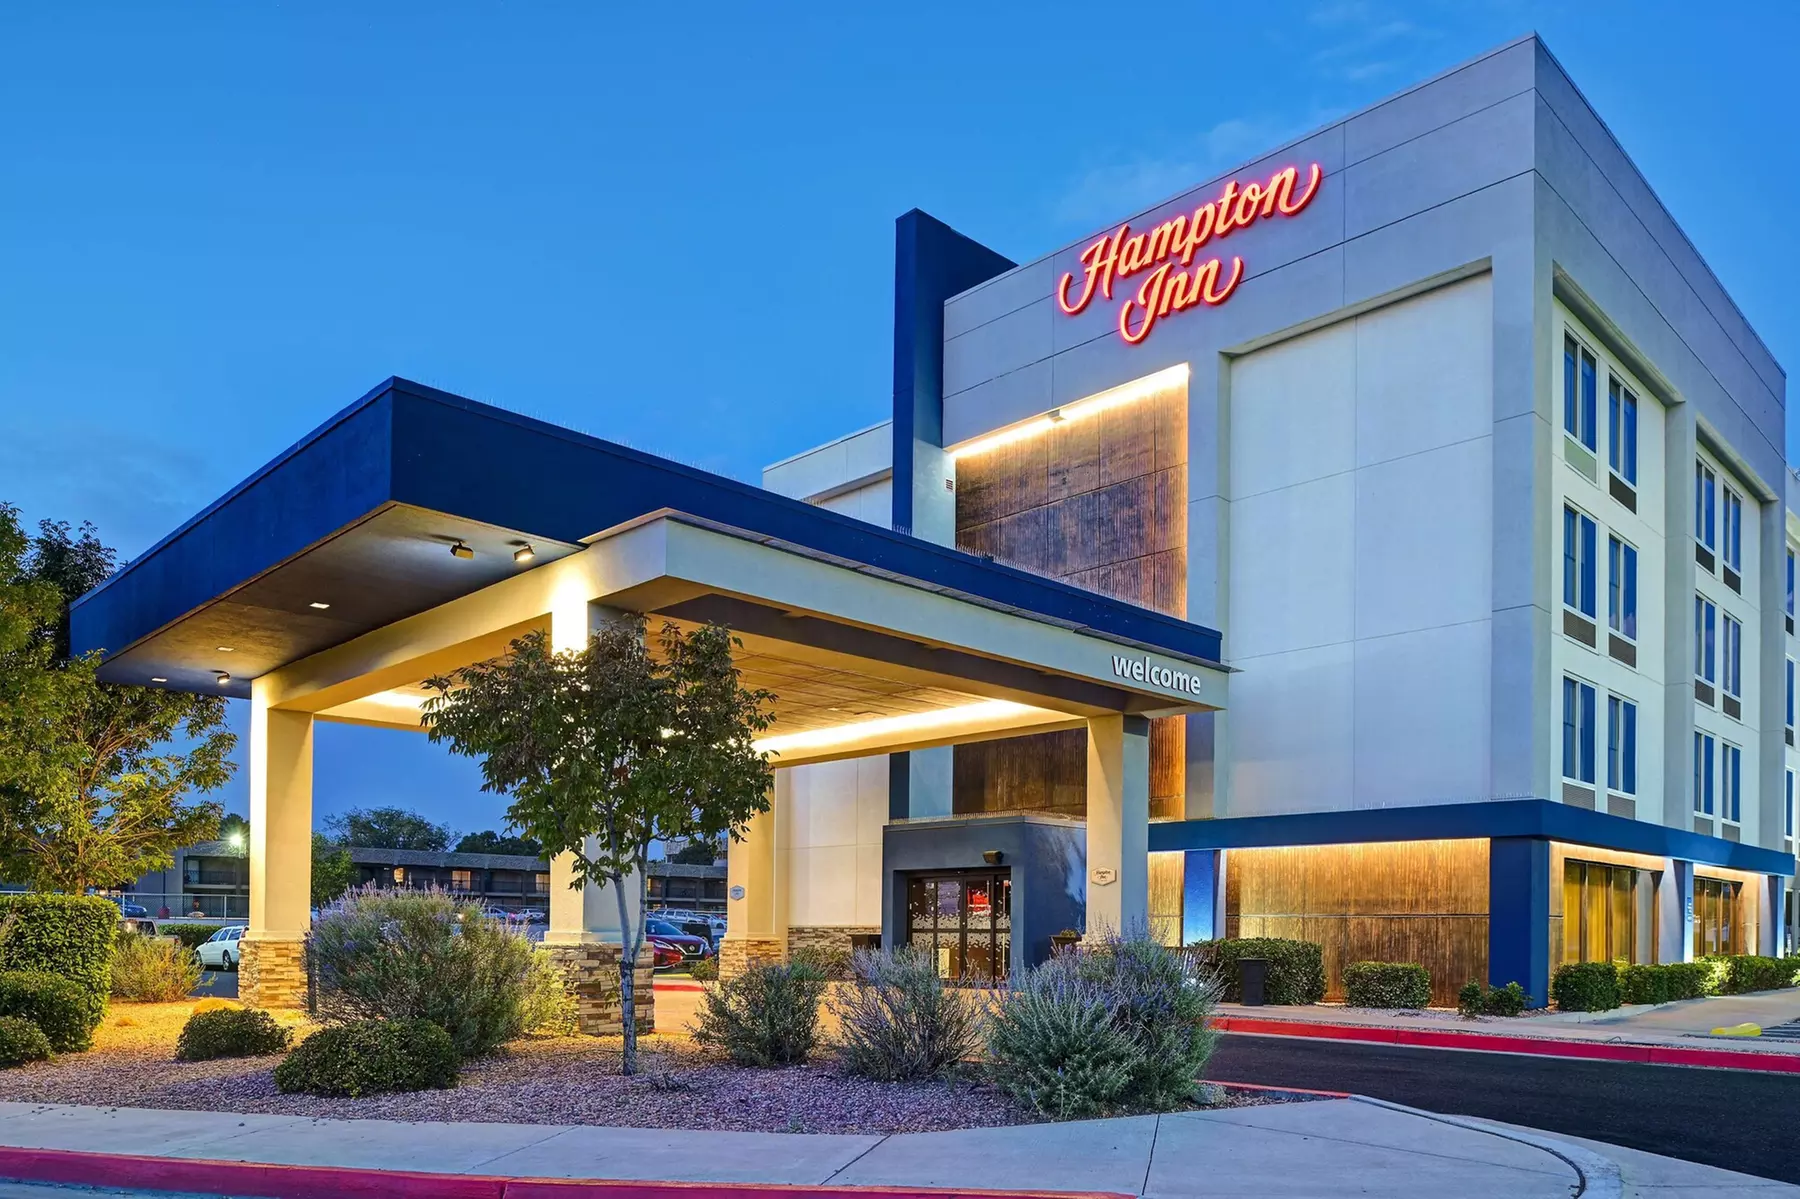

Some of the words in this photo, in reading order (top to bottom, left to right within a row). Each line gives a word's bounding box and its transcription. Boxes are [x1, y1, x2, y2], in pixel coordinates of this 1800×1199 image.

[1059, 163, 1322, 315] Hampton
[1120, 256, 1244, 344] Inn
[1112, 655, 1201, 695] welcome
